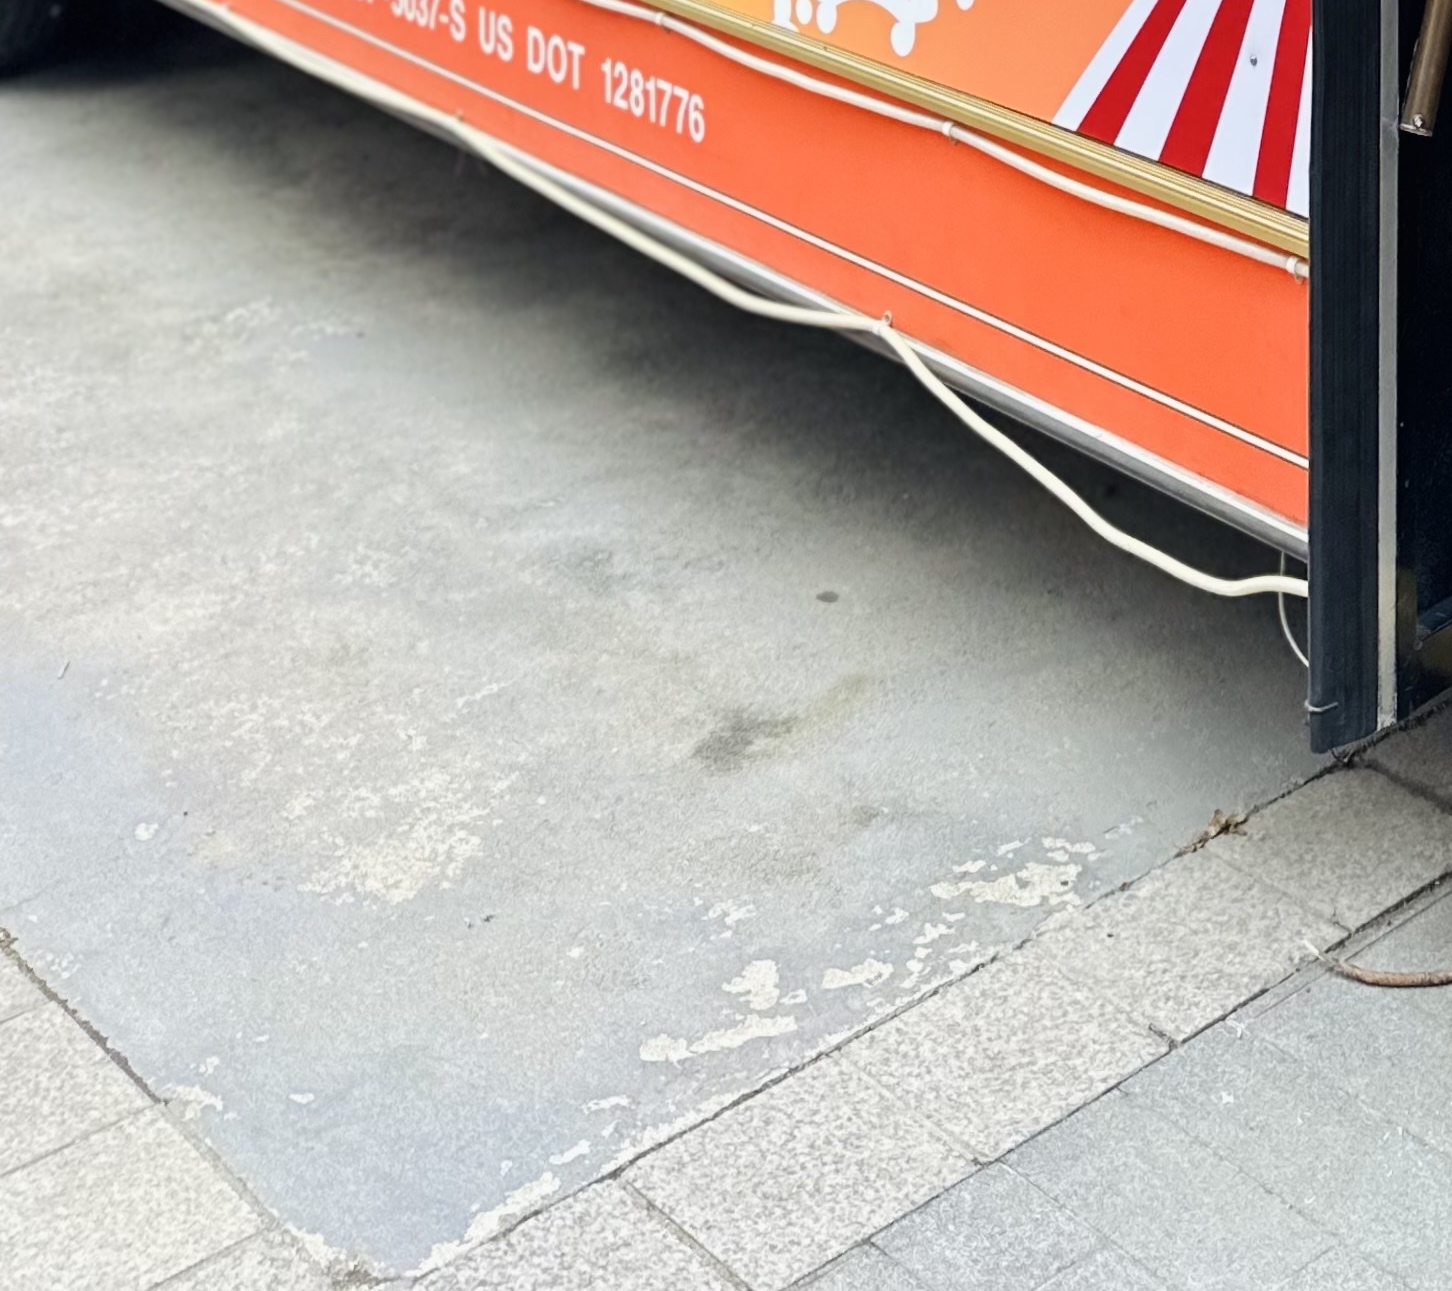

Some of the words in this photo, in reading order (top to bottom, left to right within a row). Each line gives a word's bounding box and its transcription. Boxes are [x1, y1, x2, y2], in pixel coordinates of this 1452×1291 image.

[478, 6, 514, 62] US
[527, 25, 585, 90] DOT
[601, 58, 706, 143] 1281776
